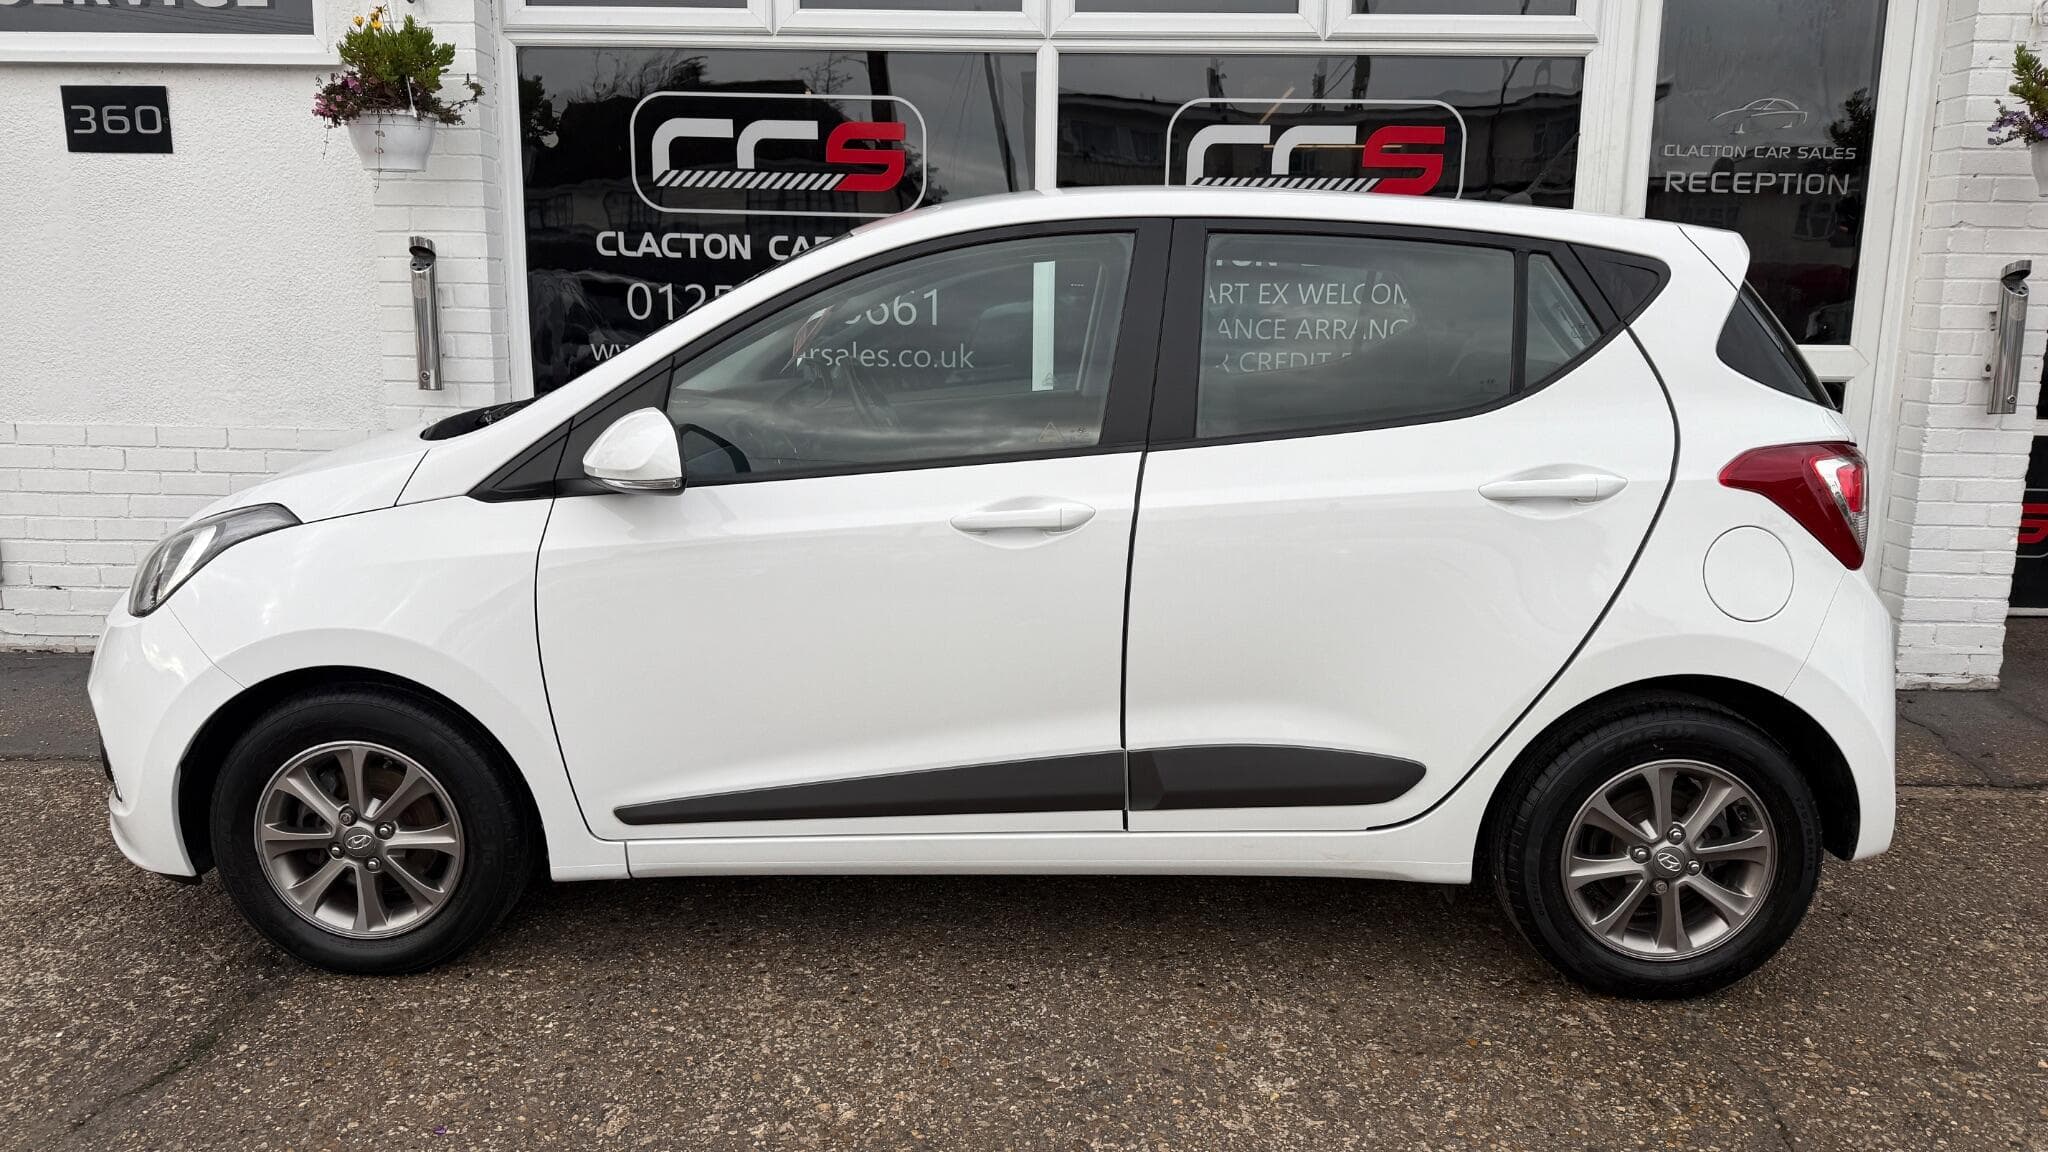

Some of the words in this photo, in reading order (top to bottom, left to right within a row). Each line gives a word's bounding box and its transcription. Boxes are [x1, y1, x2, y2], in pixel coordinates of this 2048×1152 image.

[70, 105, 163, 134] 360
[1664, 144, 1747, 158] CLACTON
[1754, 145, 1791, 159] CAR
[1797, 146, 1857, 160] SALES
[1664, 170, 1850, 195] RECEPTION
[596, 231, 751, 260] CLACTON
[768, 235, 832, 261] CA
[1258, 283, 1290, 304] EX
